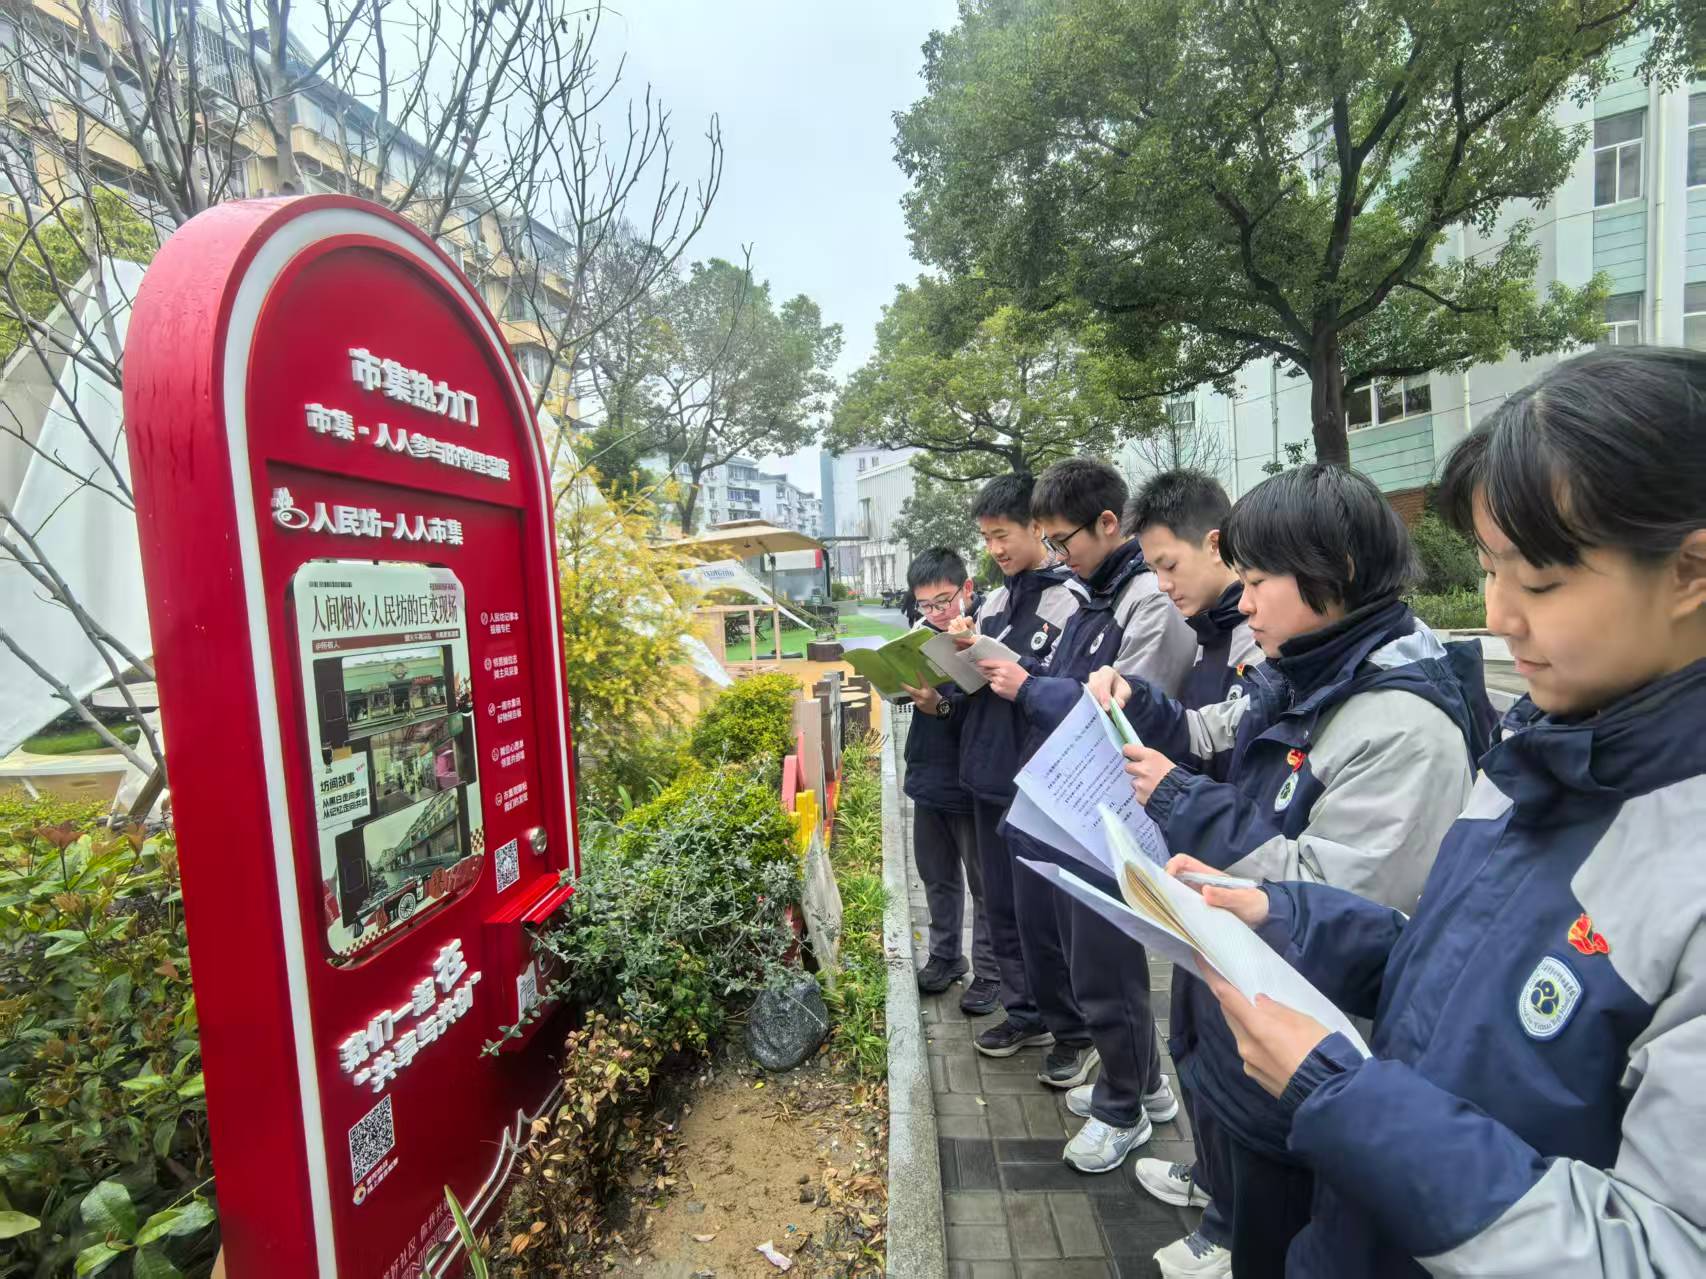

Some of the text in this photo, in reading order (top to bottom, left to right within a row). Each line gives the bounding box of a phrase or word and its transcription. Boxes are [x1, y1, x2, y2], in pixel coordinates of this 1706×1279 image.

[349, 348, 479, 427] 市集热力门
[312, 594, 458, 632] 人间烟火·人民坊的巨变现场
[320, 772, 355, 792] 坊间故事
[339, 938, 467, 1073] 我们一起在
